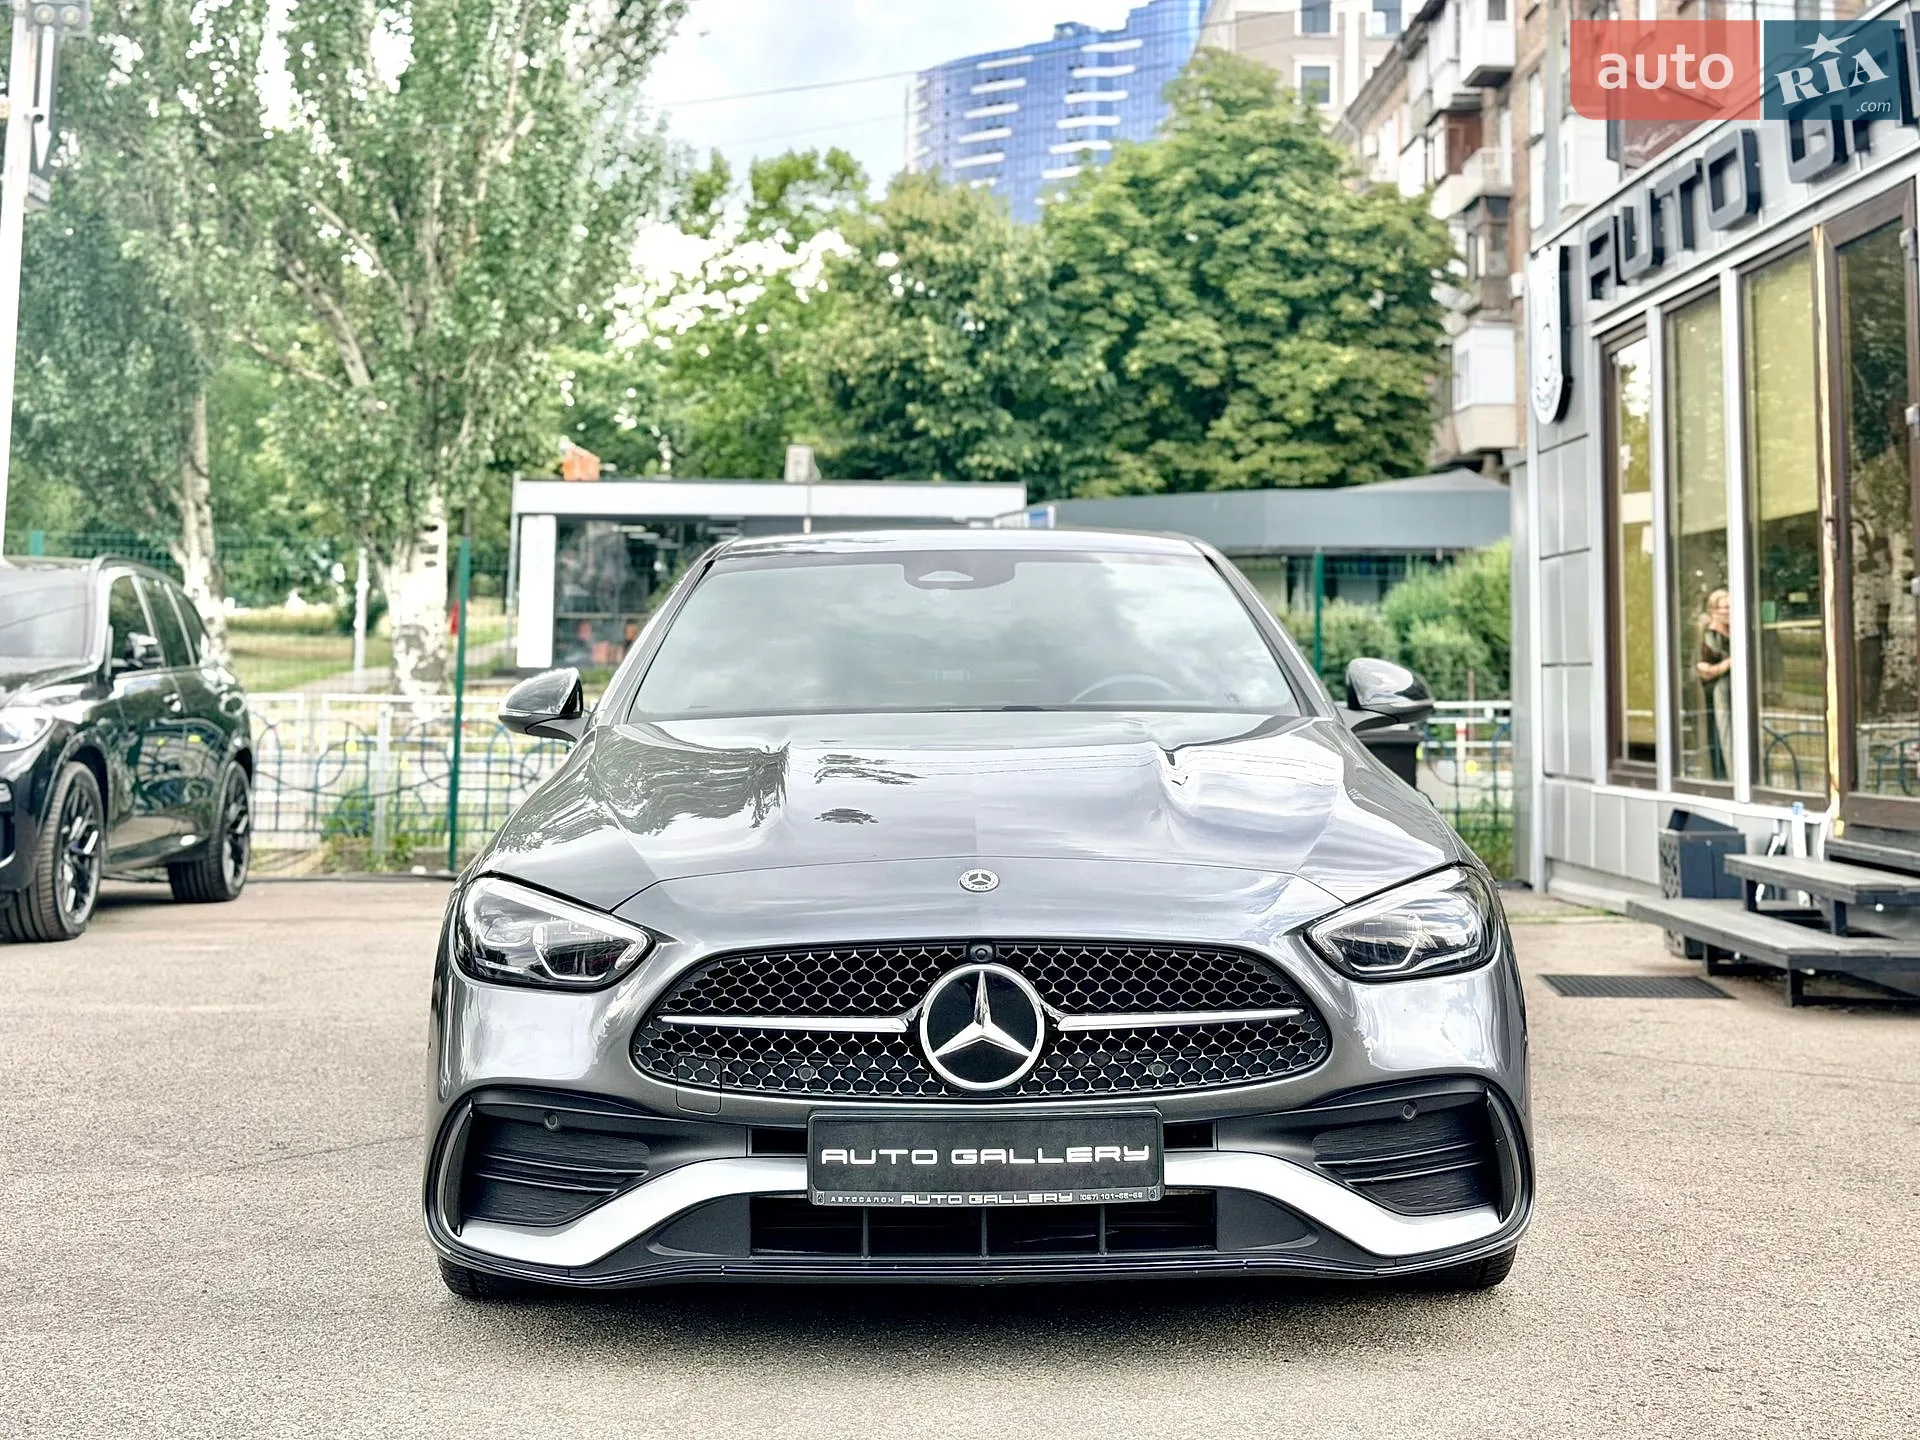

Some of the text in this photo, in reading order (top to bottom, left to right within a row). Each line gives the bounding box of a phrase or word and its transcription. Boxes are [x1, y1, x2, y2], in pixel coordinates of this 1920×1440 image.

[1585, 128, 1757, 301] AUTO
[821, 1145, 1149, 1165] AUTO GALLERY
[900, 1194, 963, 1204] AUTO
[968, 1192, 1072, 1204] GALLERY
